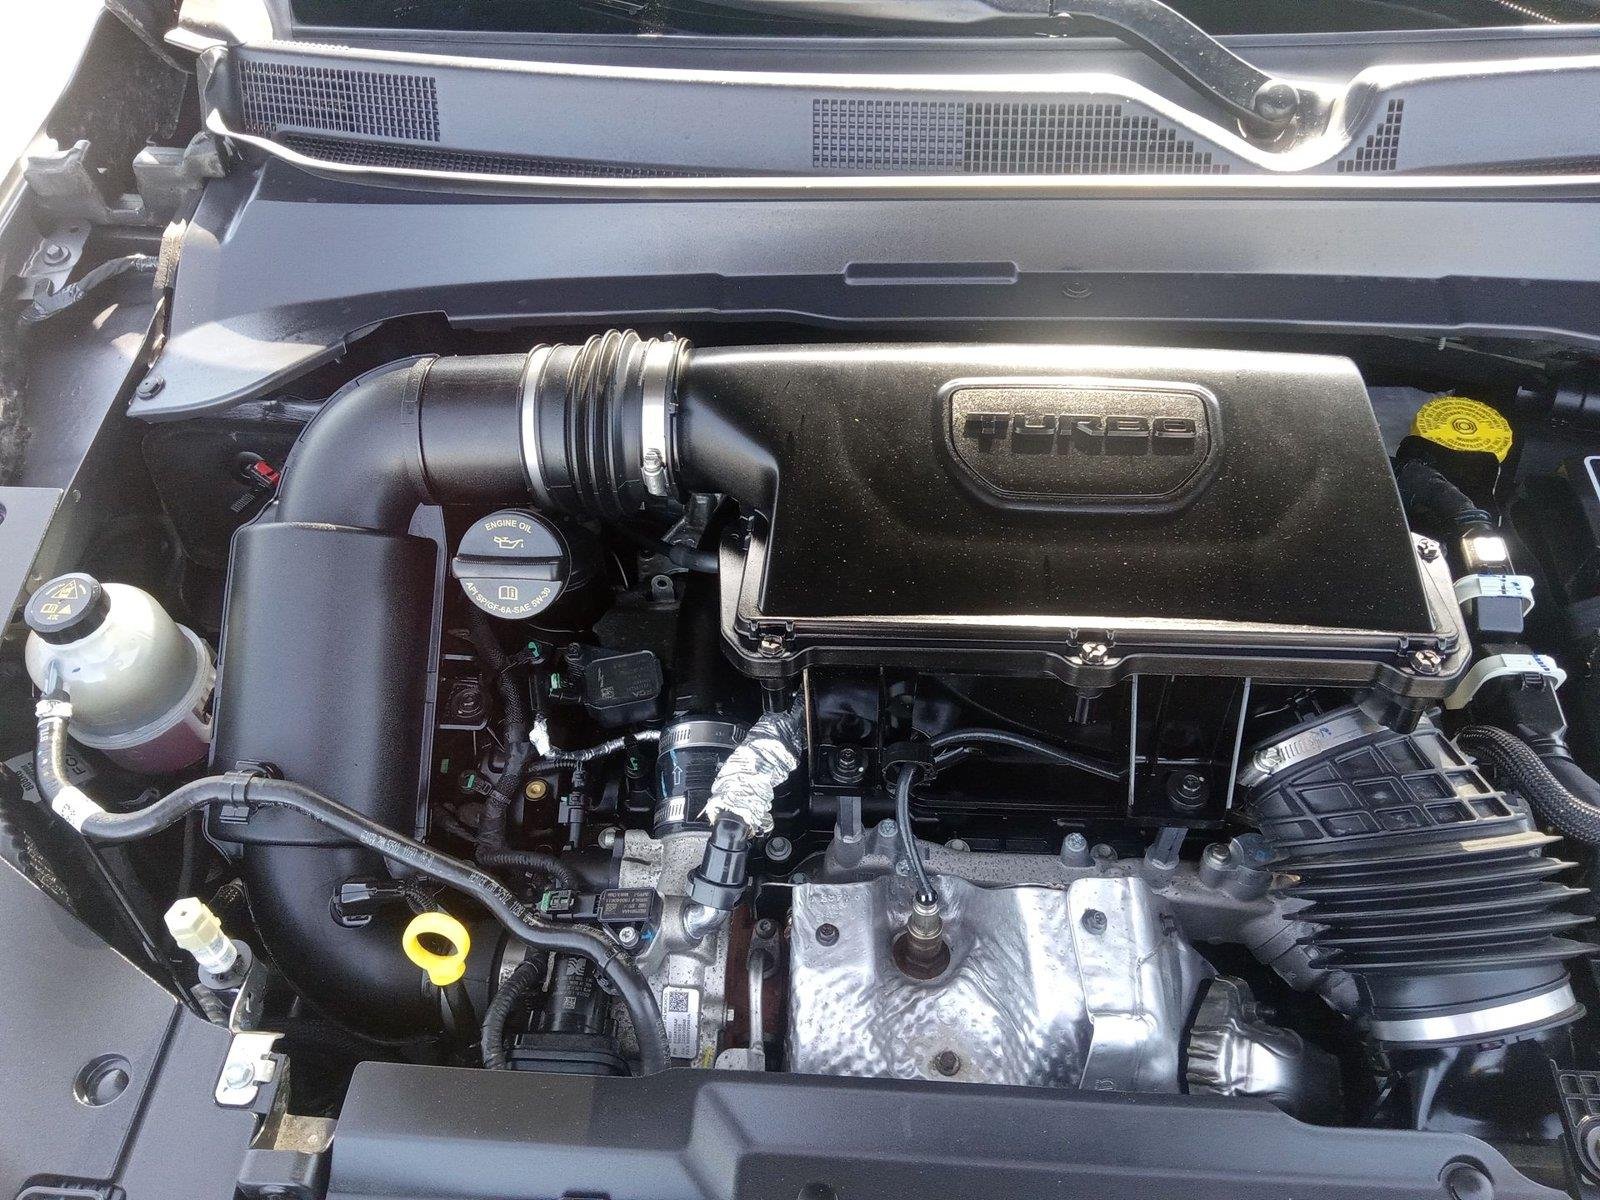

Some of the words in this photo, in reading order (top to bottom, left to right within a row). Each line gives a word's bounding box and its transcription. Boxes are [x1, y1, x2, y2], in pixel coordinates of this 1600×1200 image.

[963, 411, 1197, 439] TURBO
[484, 519, 517, 531] ENGINE
[518, 522, 532, 534] OIL
[466, 582, 478, 596] API
[531, 587, 551, 607] 5W-30
